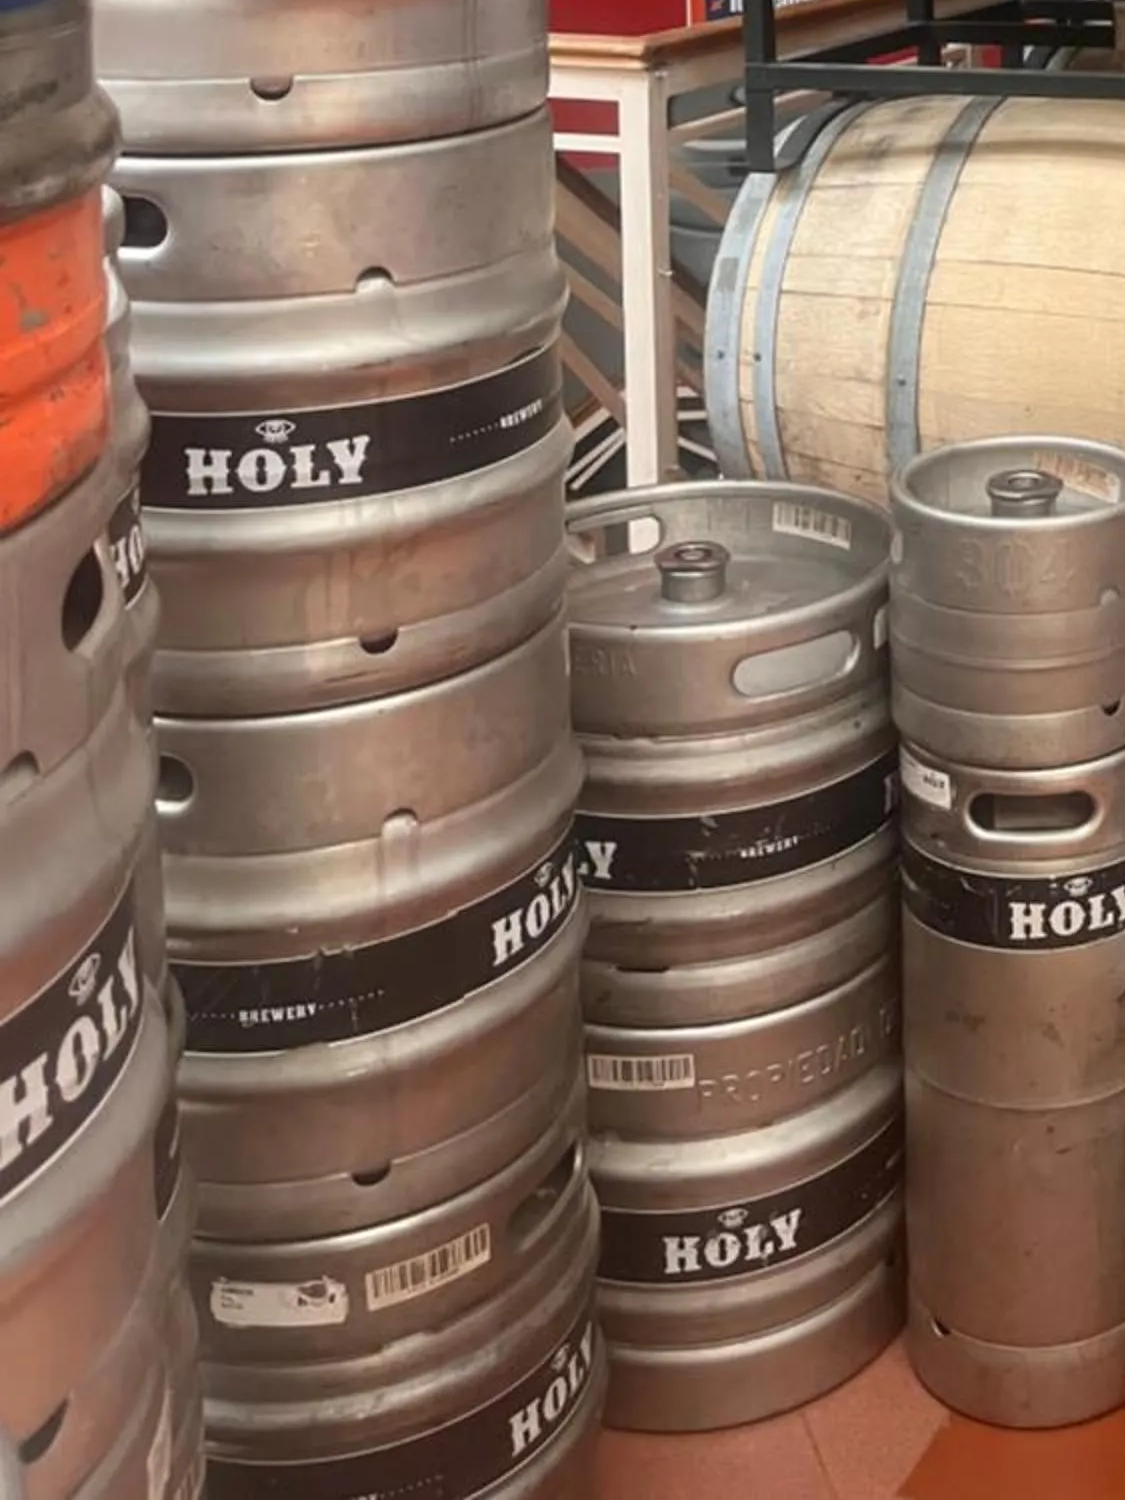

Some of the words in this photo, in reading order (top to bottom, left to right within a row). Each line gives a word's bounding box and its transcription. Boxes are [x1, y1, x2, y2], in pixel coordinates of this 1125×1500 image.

[184, 435, 371, 496] HOLY
[239, 1003, 316, 1024] BREWERY
[491, 851, 574, 967] HOLY
[0, 924, 138, 1169] HOLY
[662, 1207, 802, 1274] HOLY
[508, 1320, 592, 1457] HOLY
